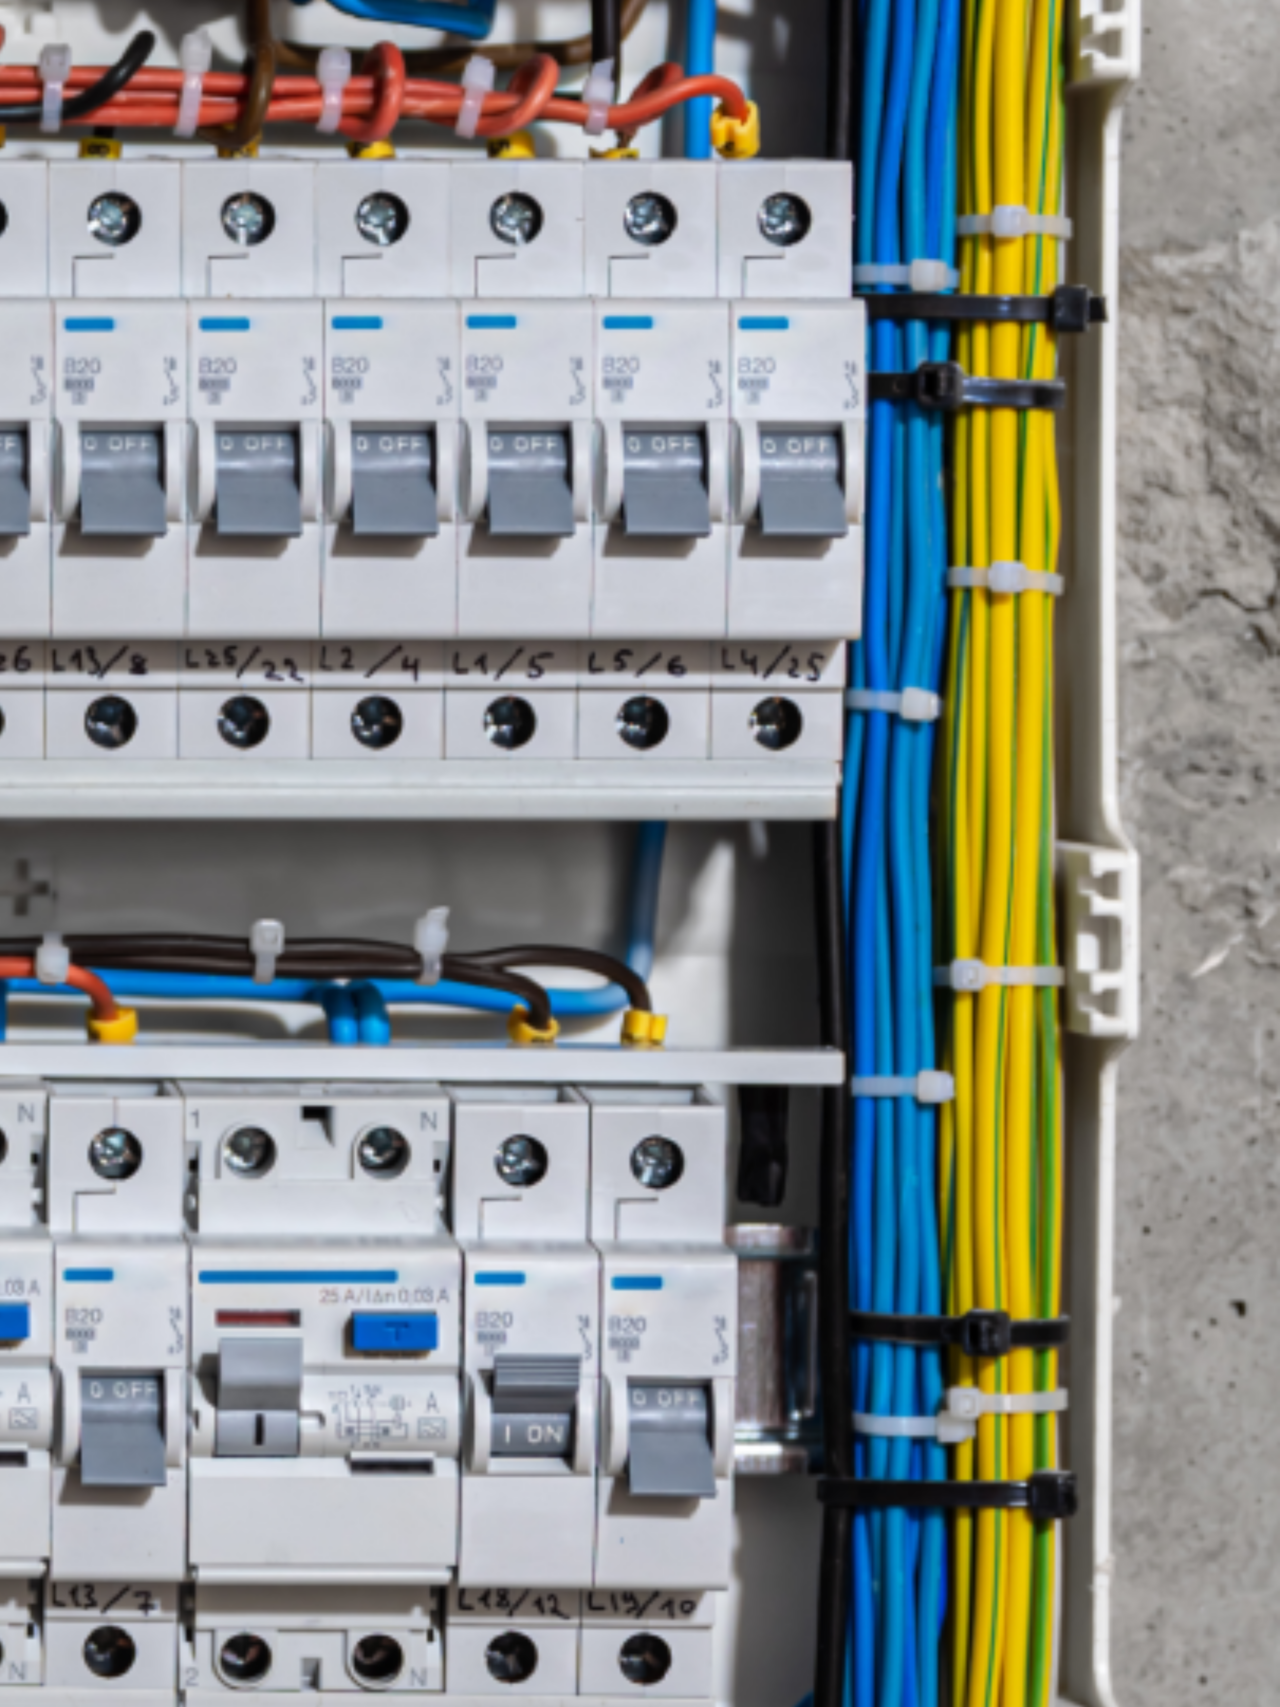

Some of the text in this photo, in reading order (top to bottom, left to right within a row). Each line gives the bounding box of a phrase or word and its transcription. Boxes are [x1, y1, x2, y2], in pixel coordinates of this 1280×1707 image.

[64, 357, 101, 375] B20
[199, 357, 236, 375] B20
[332, 357, 369, 374] B20
[602, 356, 639, 373] B20
[738, 357, 776, 374] B20
[109, 437, 151, 451] OFF
[245, 437, 286, 451] OFF
[380, 437, 422, 451] OFF
[515, 437, 558, 451] OFF
[652, 437, 695, 452] OFF
[787, 438, 830, 454] OFF
[18, 1105, 35, 1122] N
[420, 1112, 438, 1130] N
[27, 1279, 41, 1297] A
[436, 1286, 450, 1304] A
[114, 1382, 156, 1398] OFF
[658, 1390, 699, 1406] OFF
[527, 1424, 564, 1444] ON
[9, 1663, 26, 1680] N
[410, 1669, 426, 1686] N
